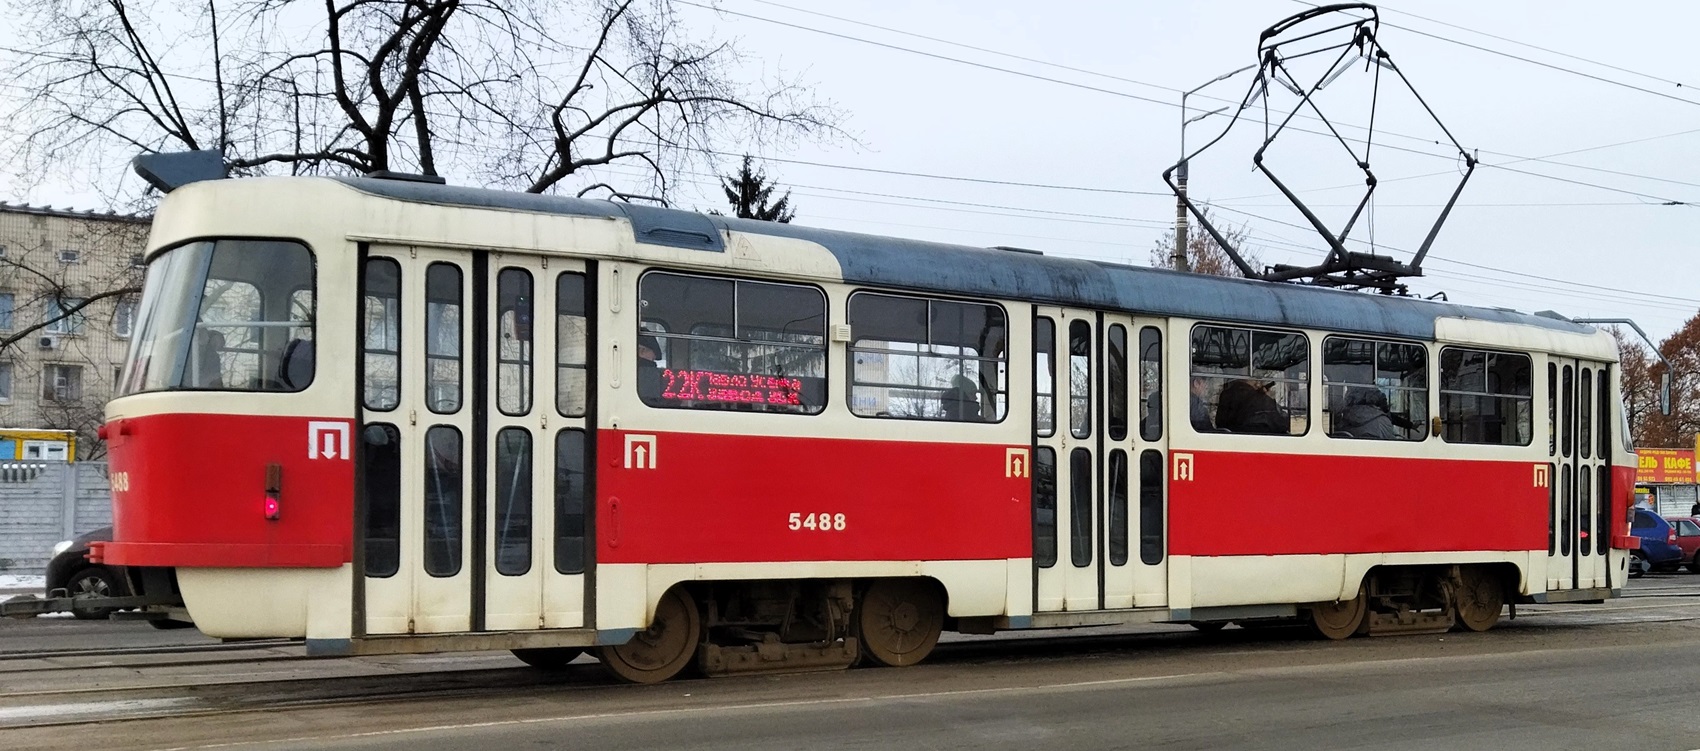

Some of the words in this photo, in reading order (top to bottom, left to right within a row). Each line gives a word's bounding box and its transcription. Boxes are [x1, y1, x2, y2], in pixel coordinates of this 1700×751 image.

[1639, 456, 1658, 469] ЕЛЬ
[1663, 457, 1692, 469] КАФЕ
[788, 512, 846, 531] 5488
